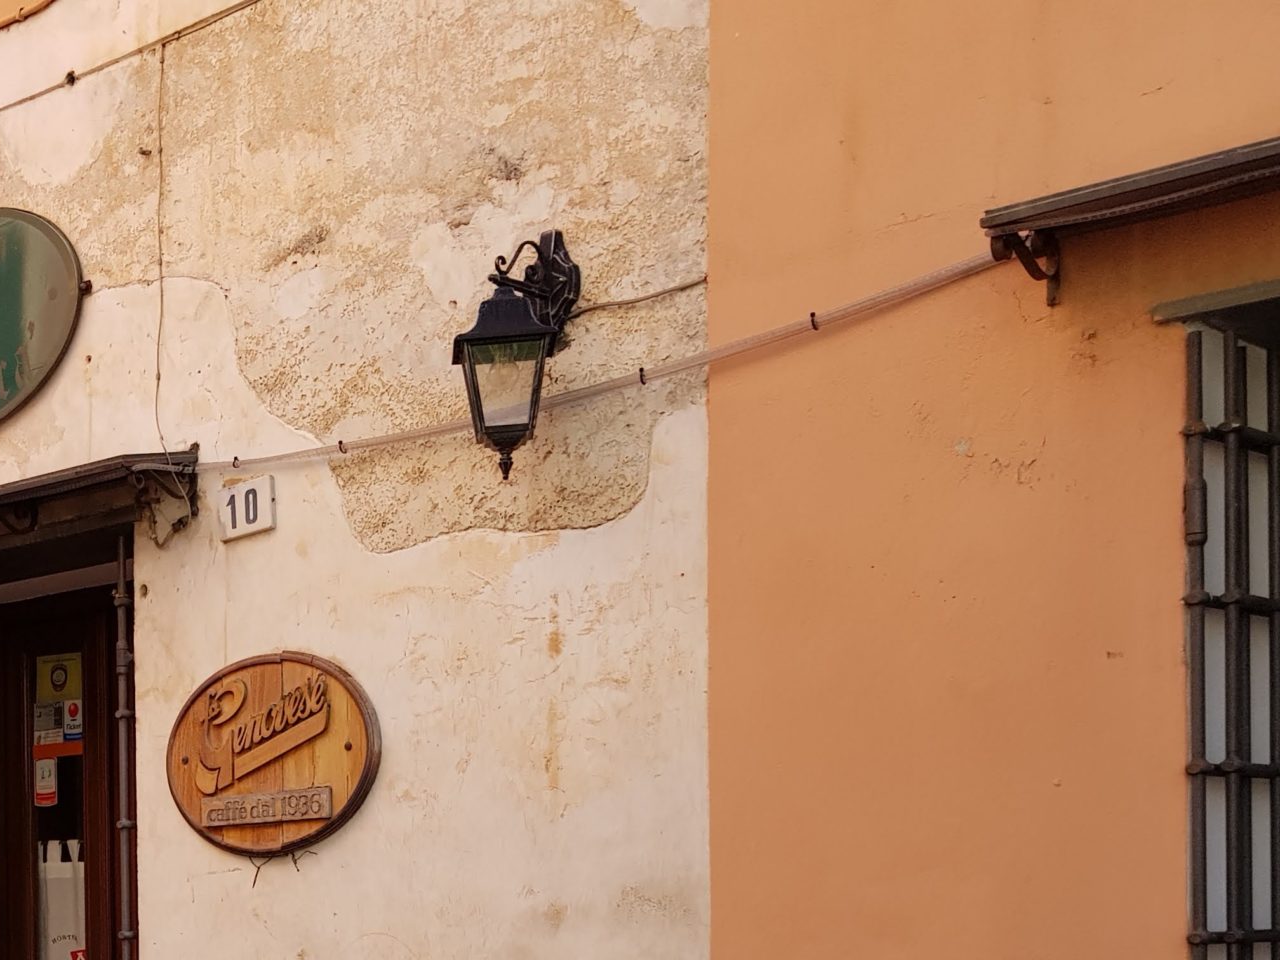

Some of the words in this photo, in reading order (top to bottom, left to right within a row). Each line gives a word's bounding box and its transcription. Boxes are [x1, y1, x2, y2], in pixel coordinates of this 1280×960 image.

[226, 488, 258, 529] 10
[250, 798, 276, 819] dal
[281, 793, 323, 817] 1936
